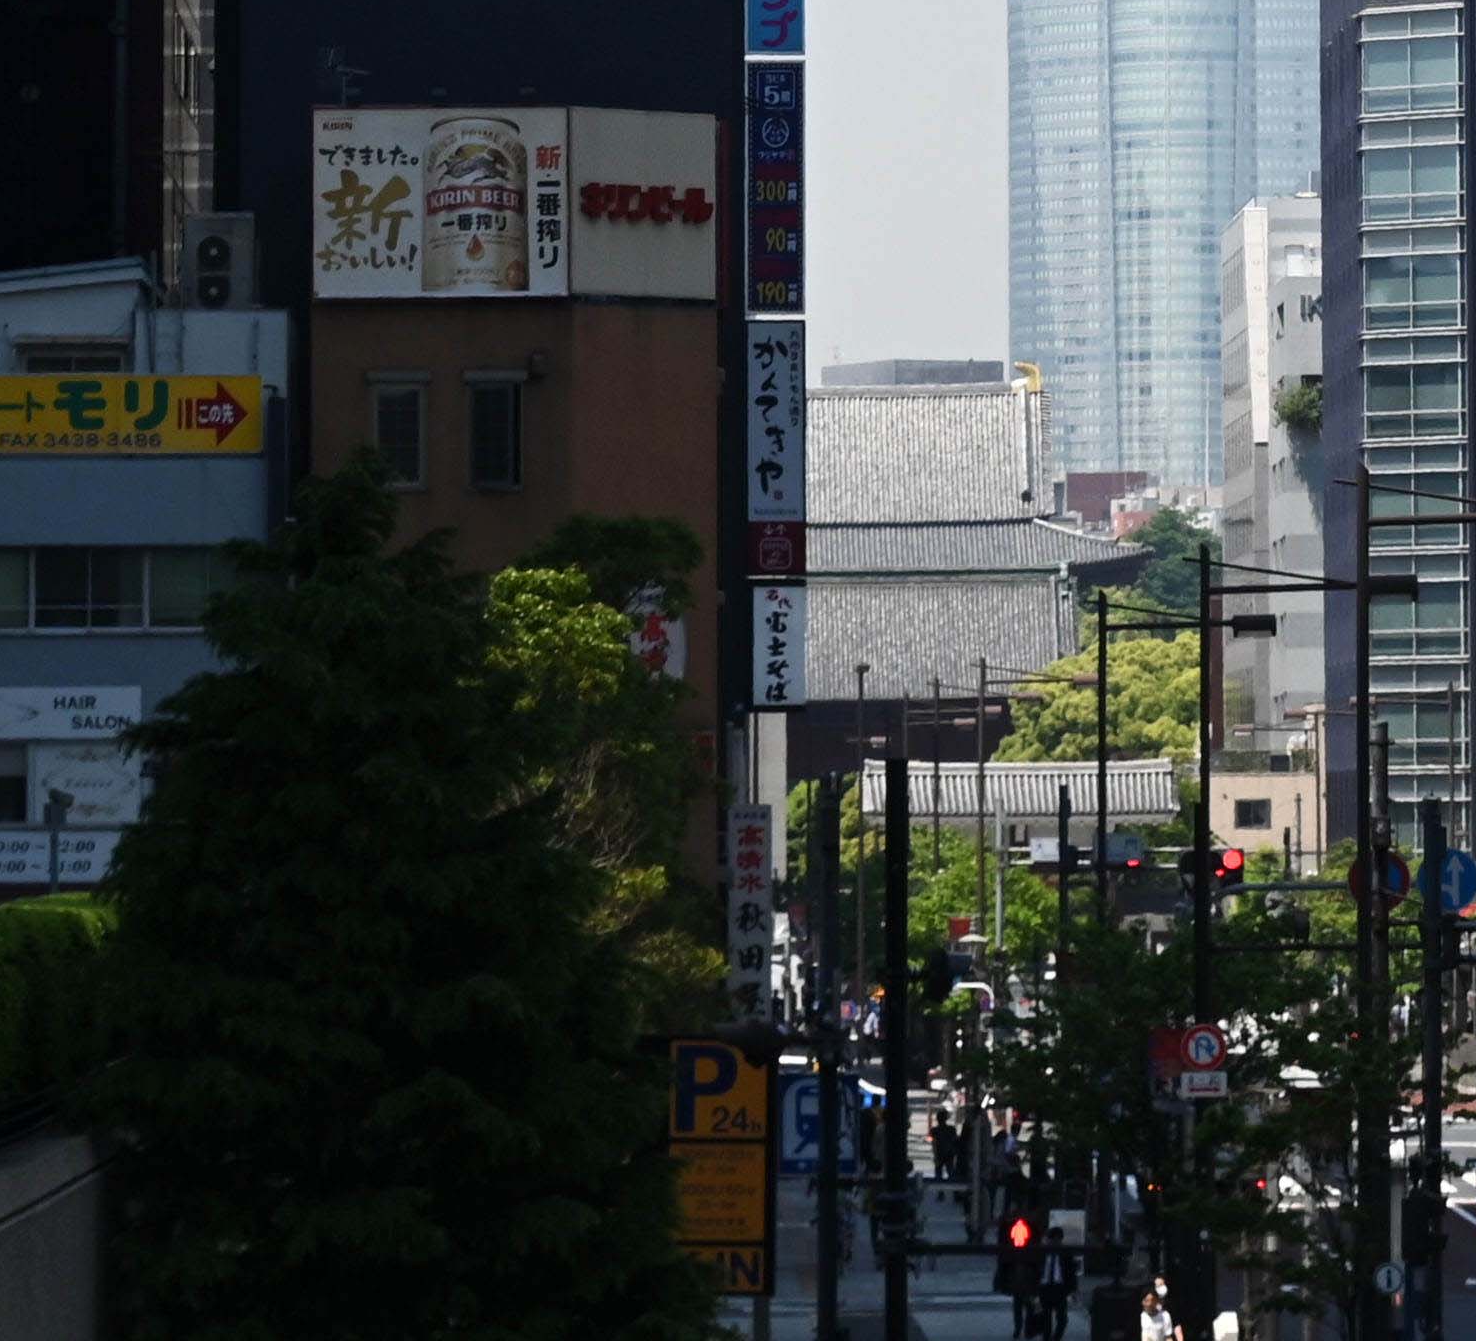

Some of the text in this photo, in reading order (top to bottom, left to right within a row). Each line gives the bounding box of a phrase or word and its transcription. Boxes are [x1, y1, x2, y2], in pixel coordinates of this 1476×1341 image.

[319, 145, 419, 167] できました。
[321, 169, 413, 251] 新
[430, 189, 521, 209] KIRIN BEER
[441, 215, 507, 231] 一番搾り
[316, 244, 417, 271] おいしい!
[54, 381, 169, 430] モリ
[197, 403, 236, 427] この先
[753, 335, 788, 494] かんてきや
[53, 696, 97, 710] HAIR
[71, 715, 132, 732] SALON
[677, 1045, 738, 1132] P
